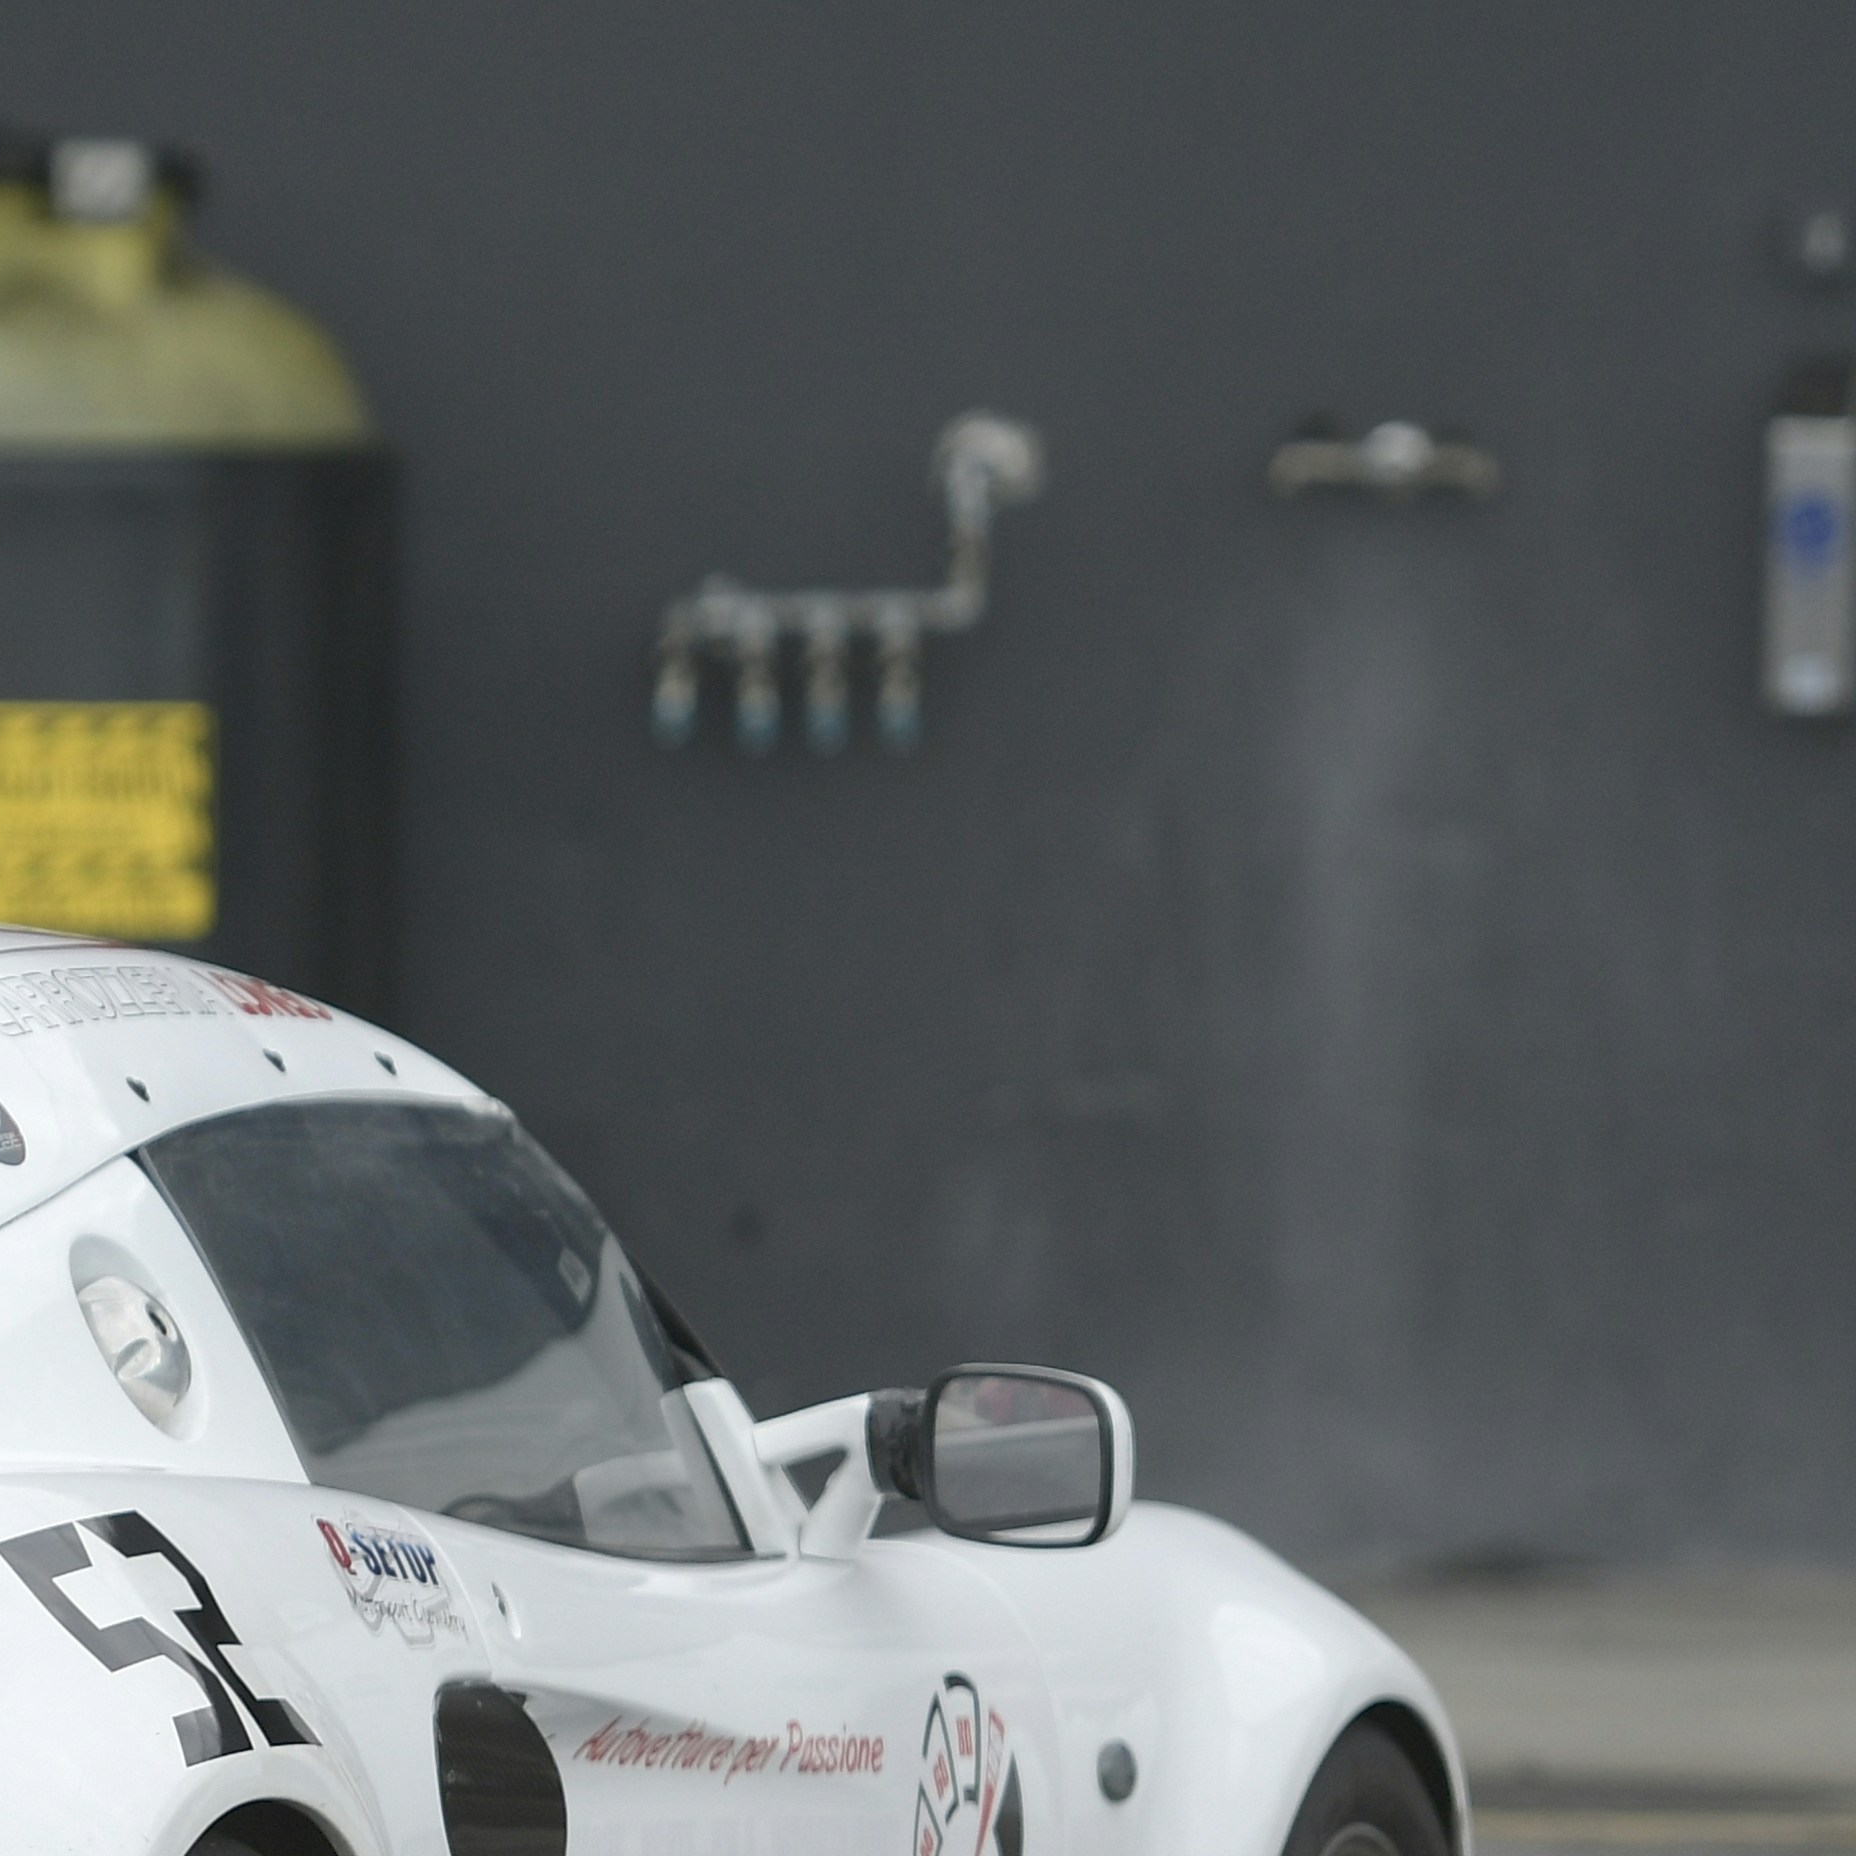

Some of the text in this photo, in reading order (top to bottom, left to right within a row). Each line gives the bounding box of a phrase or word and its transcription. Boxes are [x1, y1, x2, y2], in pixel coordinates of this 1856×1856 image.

[315, 1517, 440, 1588] Q-SETUP
[572, 1714, 885, 1787] Autovetture per Passione
